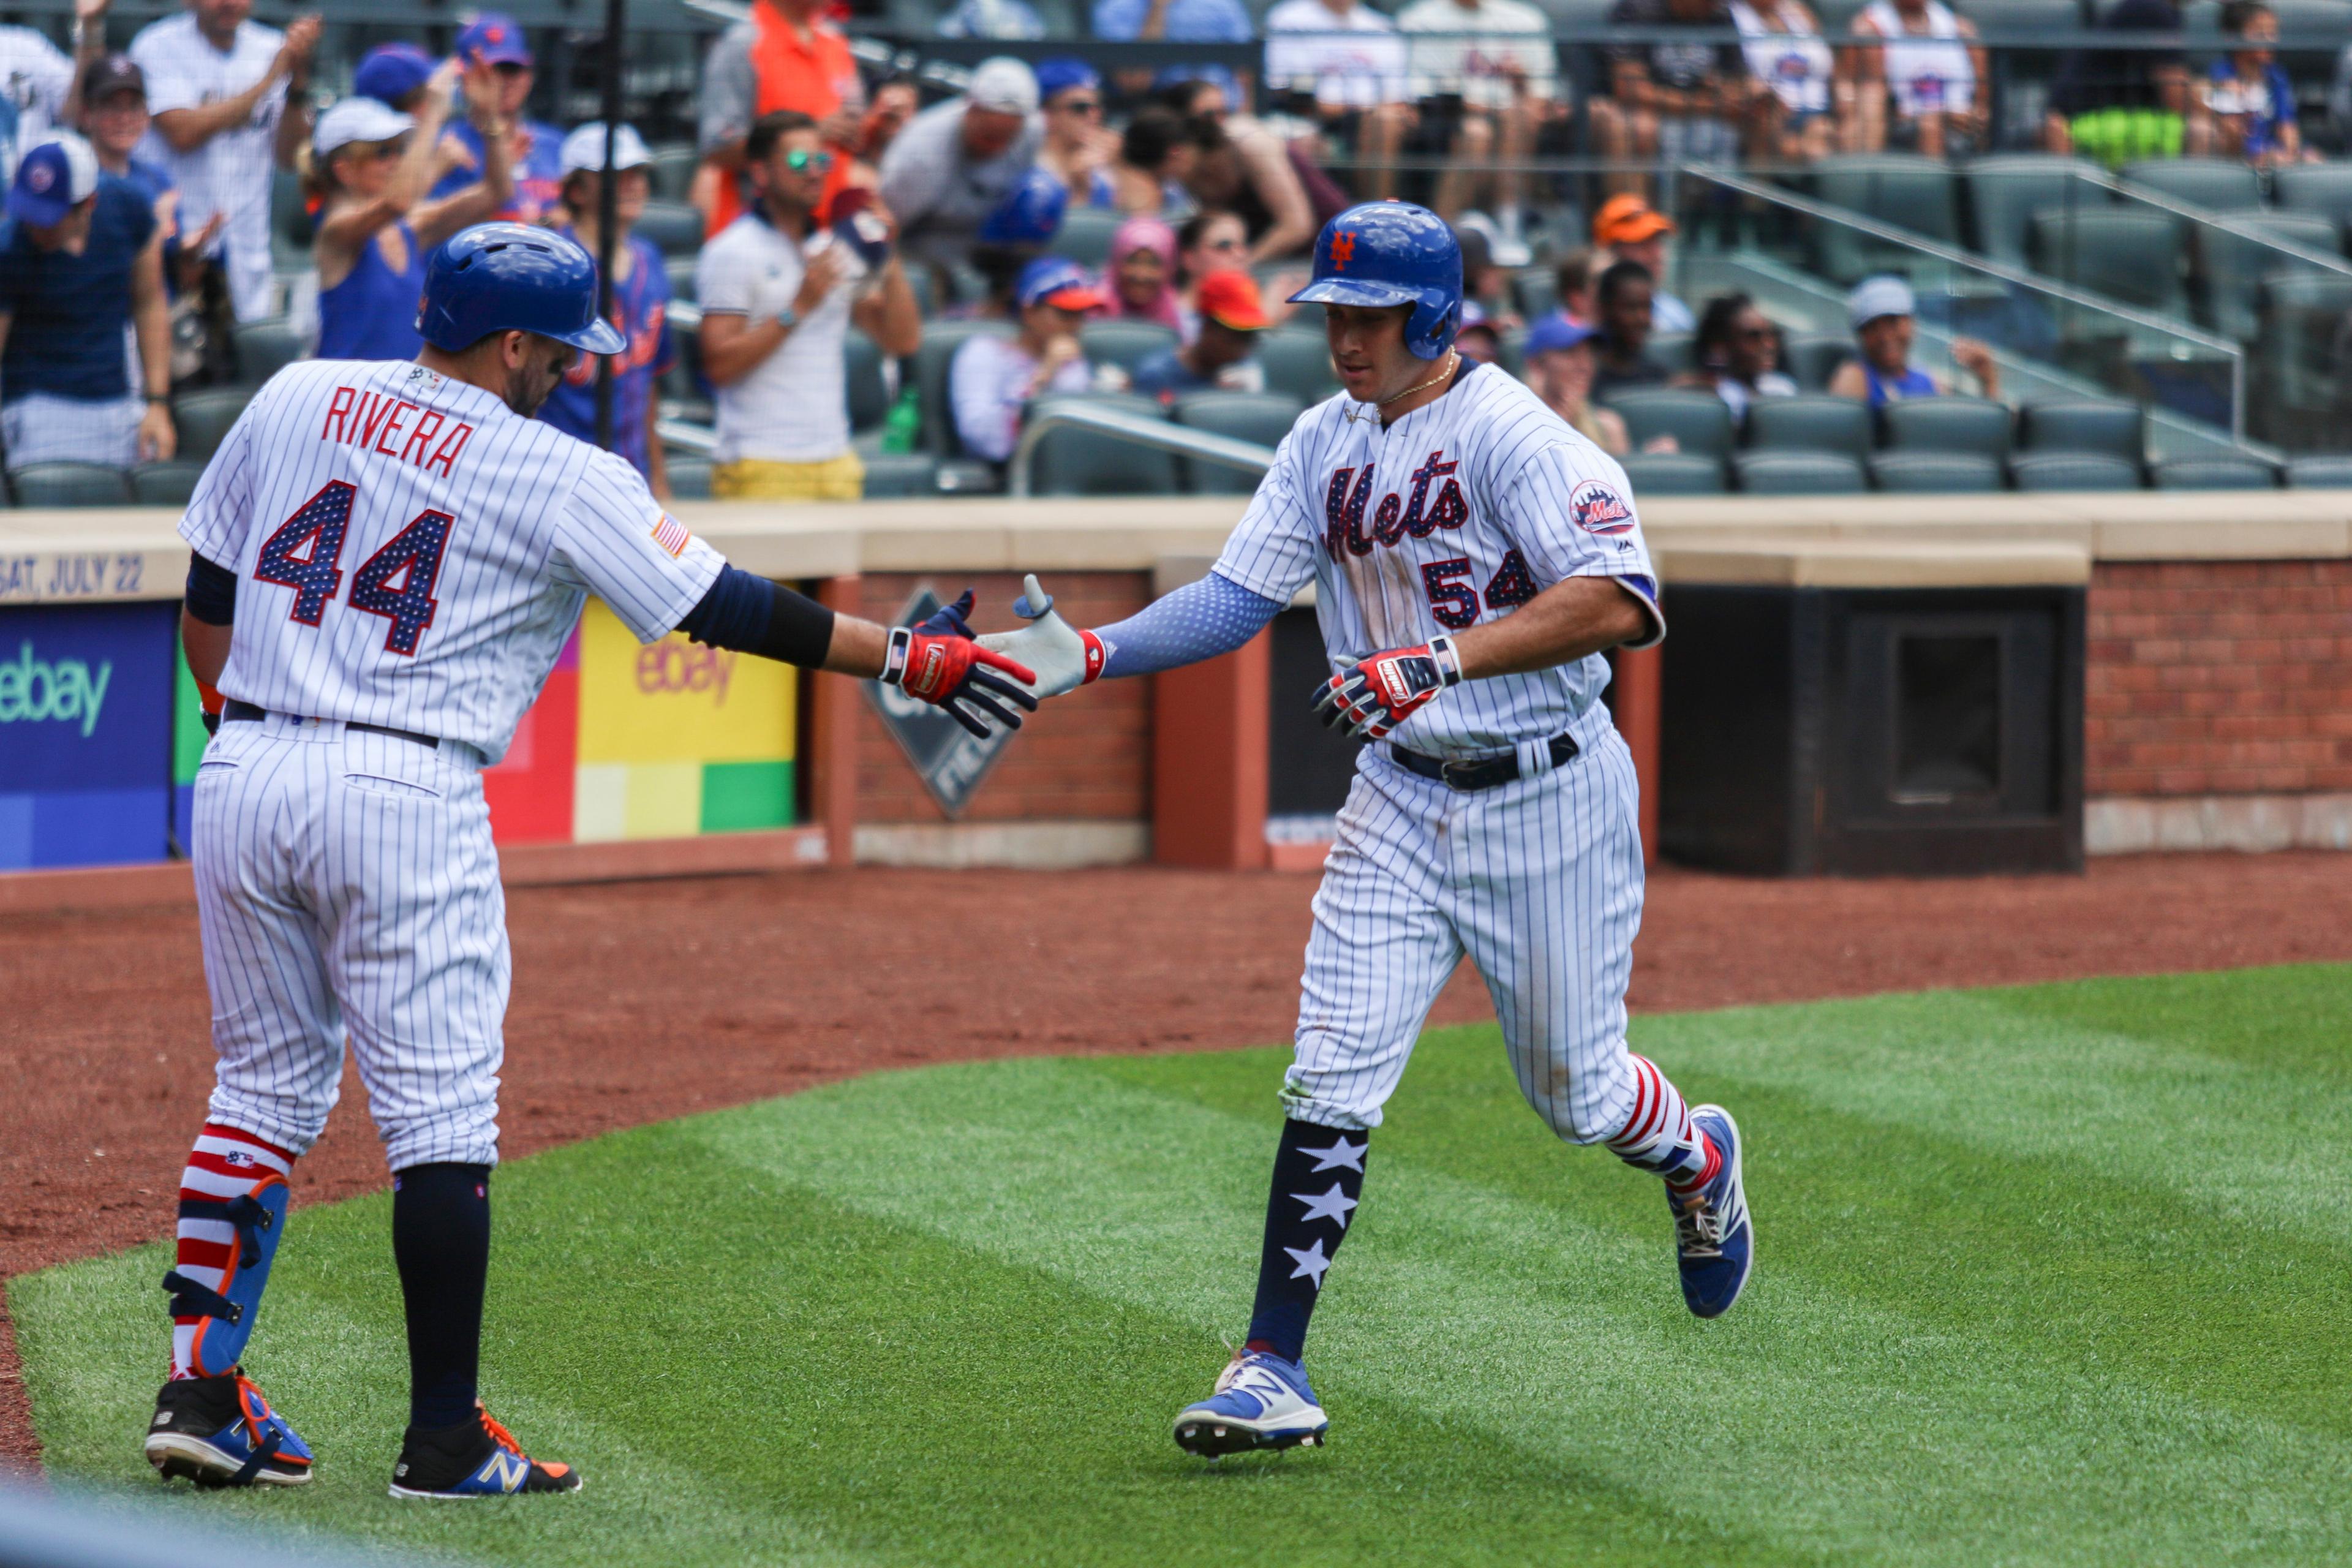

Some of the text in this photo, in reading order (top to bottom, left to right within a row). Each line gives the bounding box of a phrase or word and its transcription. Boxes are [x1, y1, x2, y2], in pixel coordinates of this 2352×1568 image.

[322, 386, 474, 478] RIVERA
[1320, 450, 1469, 565] Mets
[1585, 497, 1628, 525] Mets
[49, 554, 109, 595] JULY
[115, 553, 145, 593] 22
[253, 478, 456, 658] 44
[1420, 549, 1539, 630] 54
[0, 639, 113, 737] ebay
